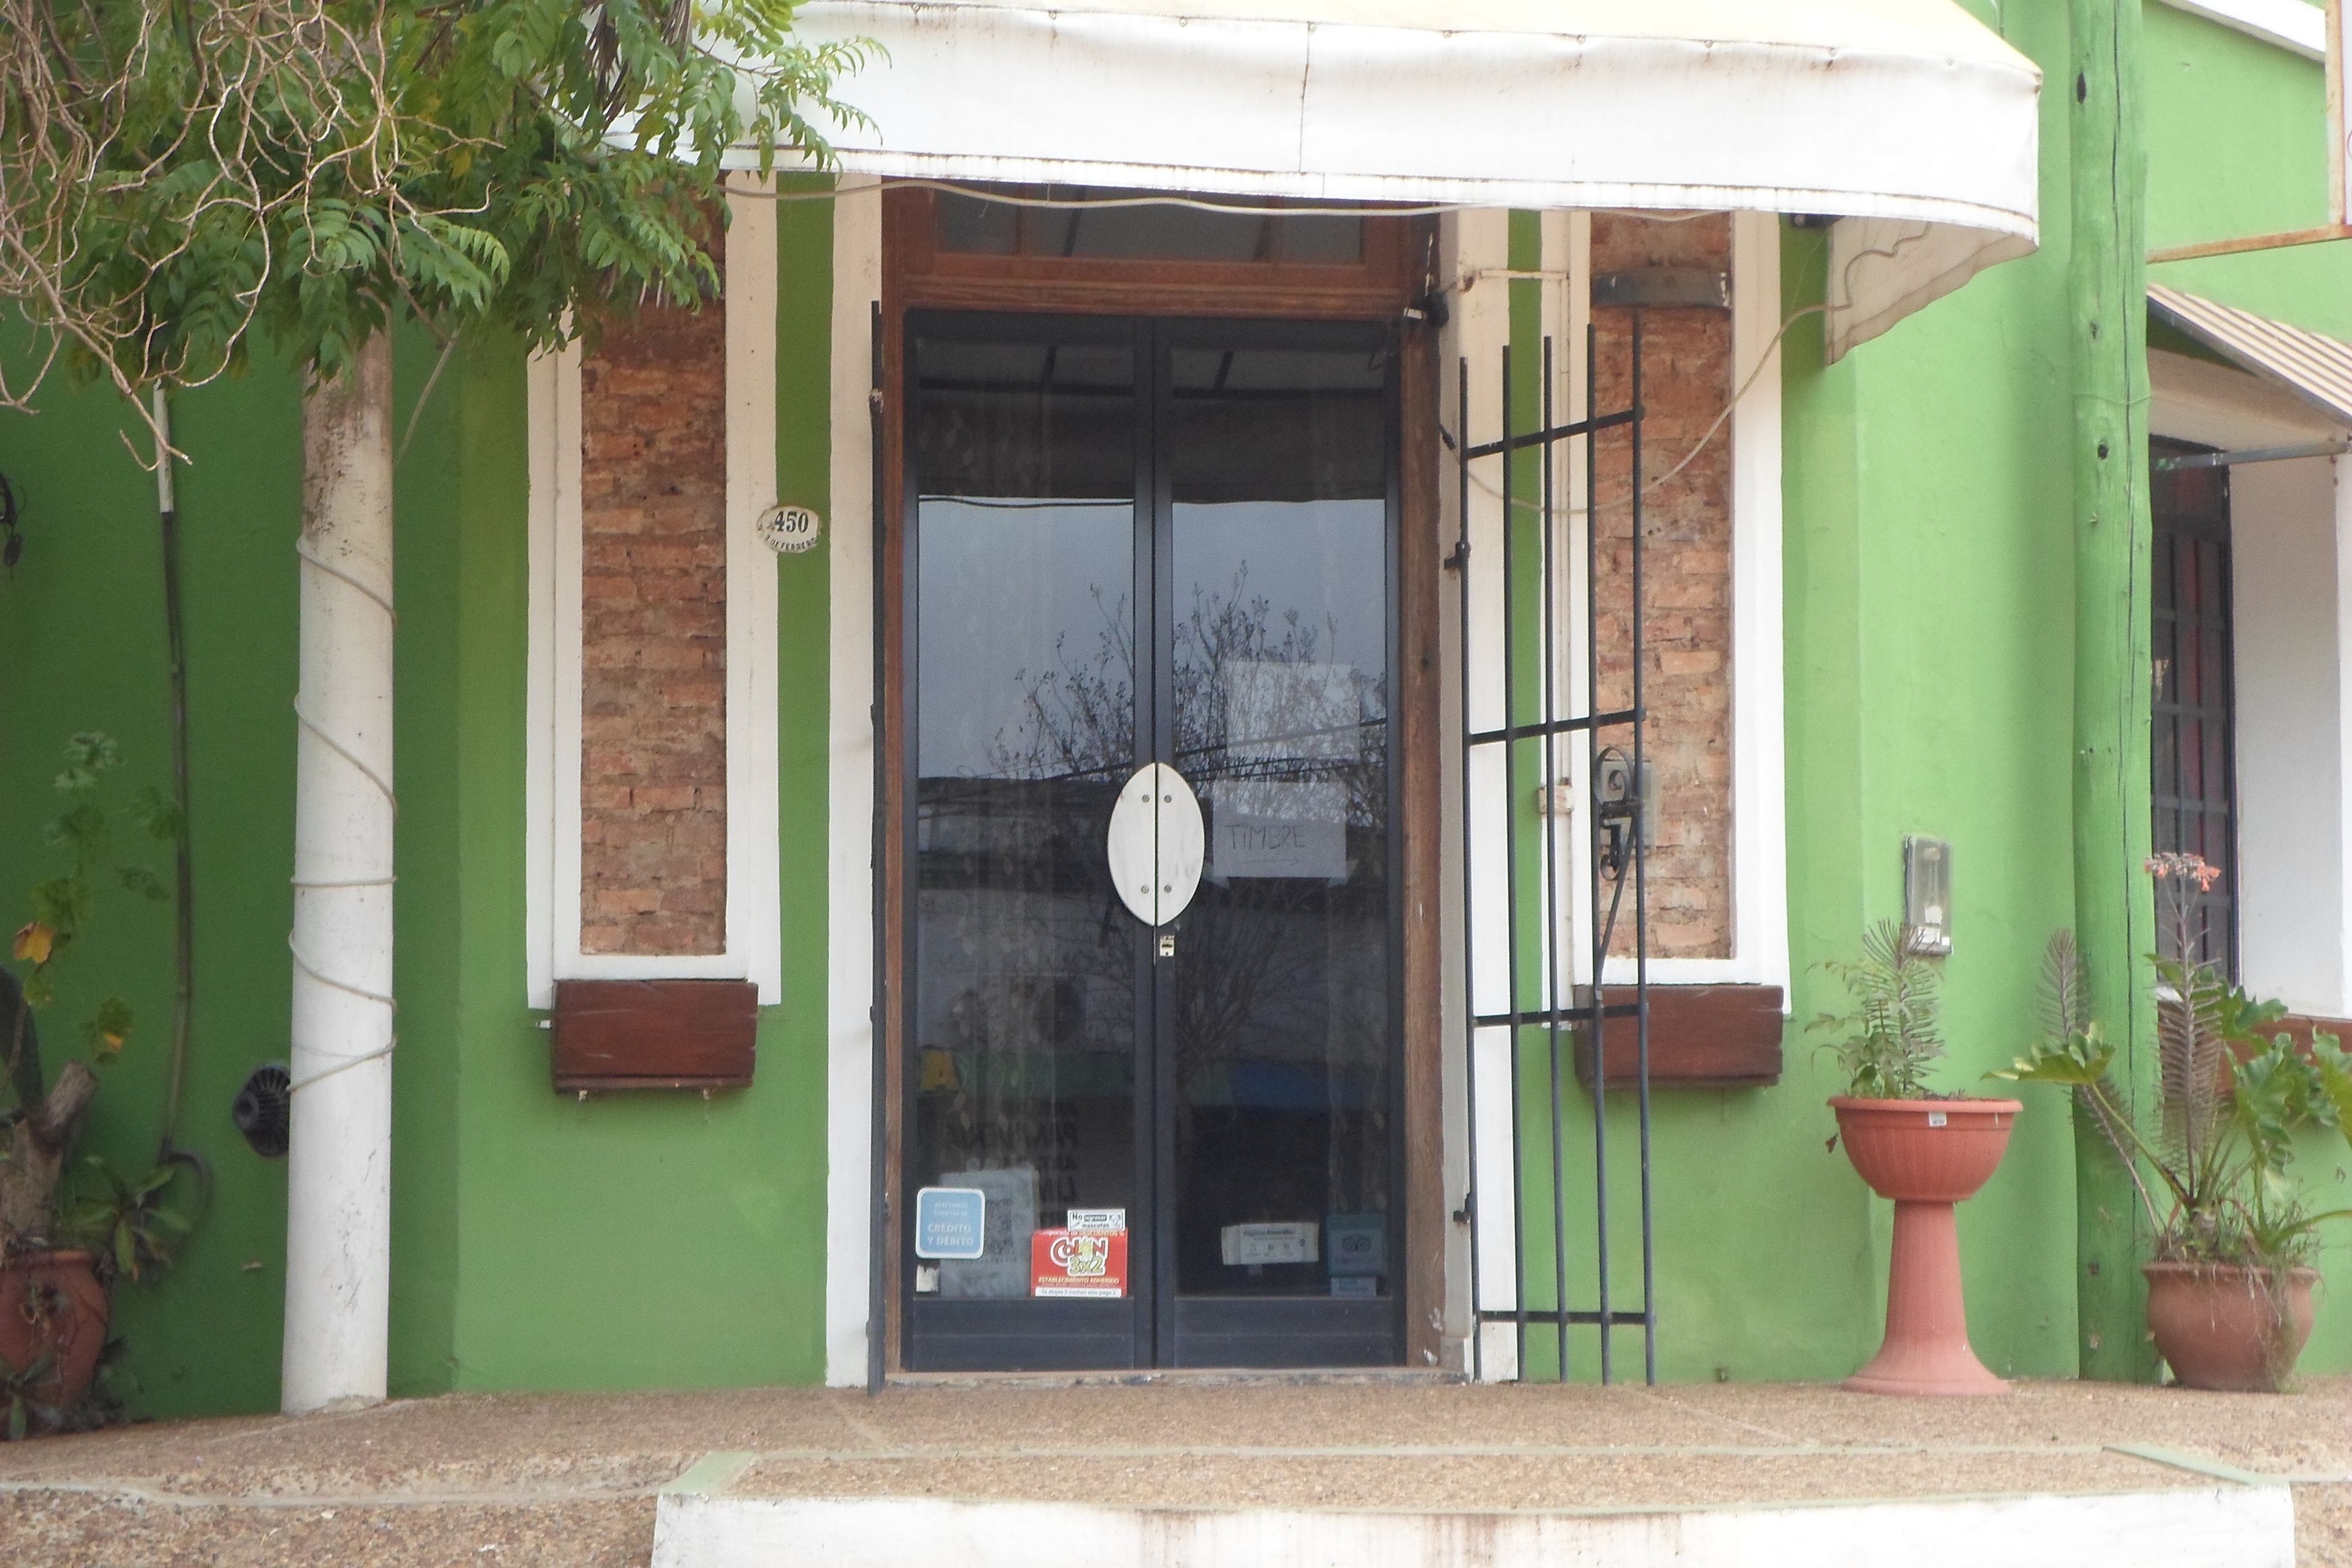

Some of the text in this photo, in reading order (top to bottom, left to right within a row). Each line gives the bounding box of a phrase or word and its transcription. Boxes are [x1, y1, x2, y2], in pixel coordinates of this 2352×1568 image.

[774, 511, 809, 533] 450
[1224, 823, 1306, 850] TIMBRE
[927, 1236, 934, 1245] Y
